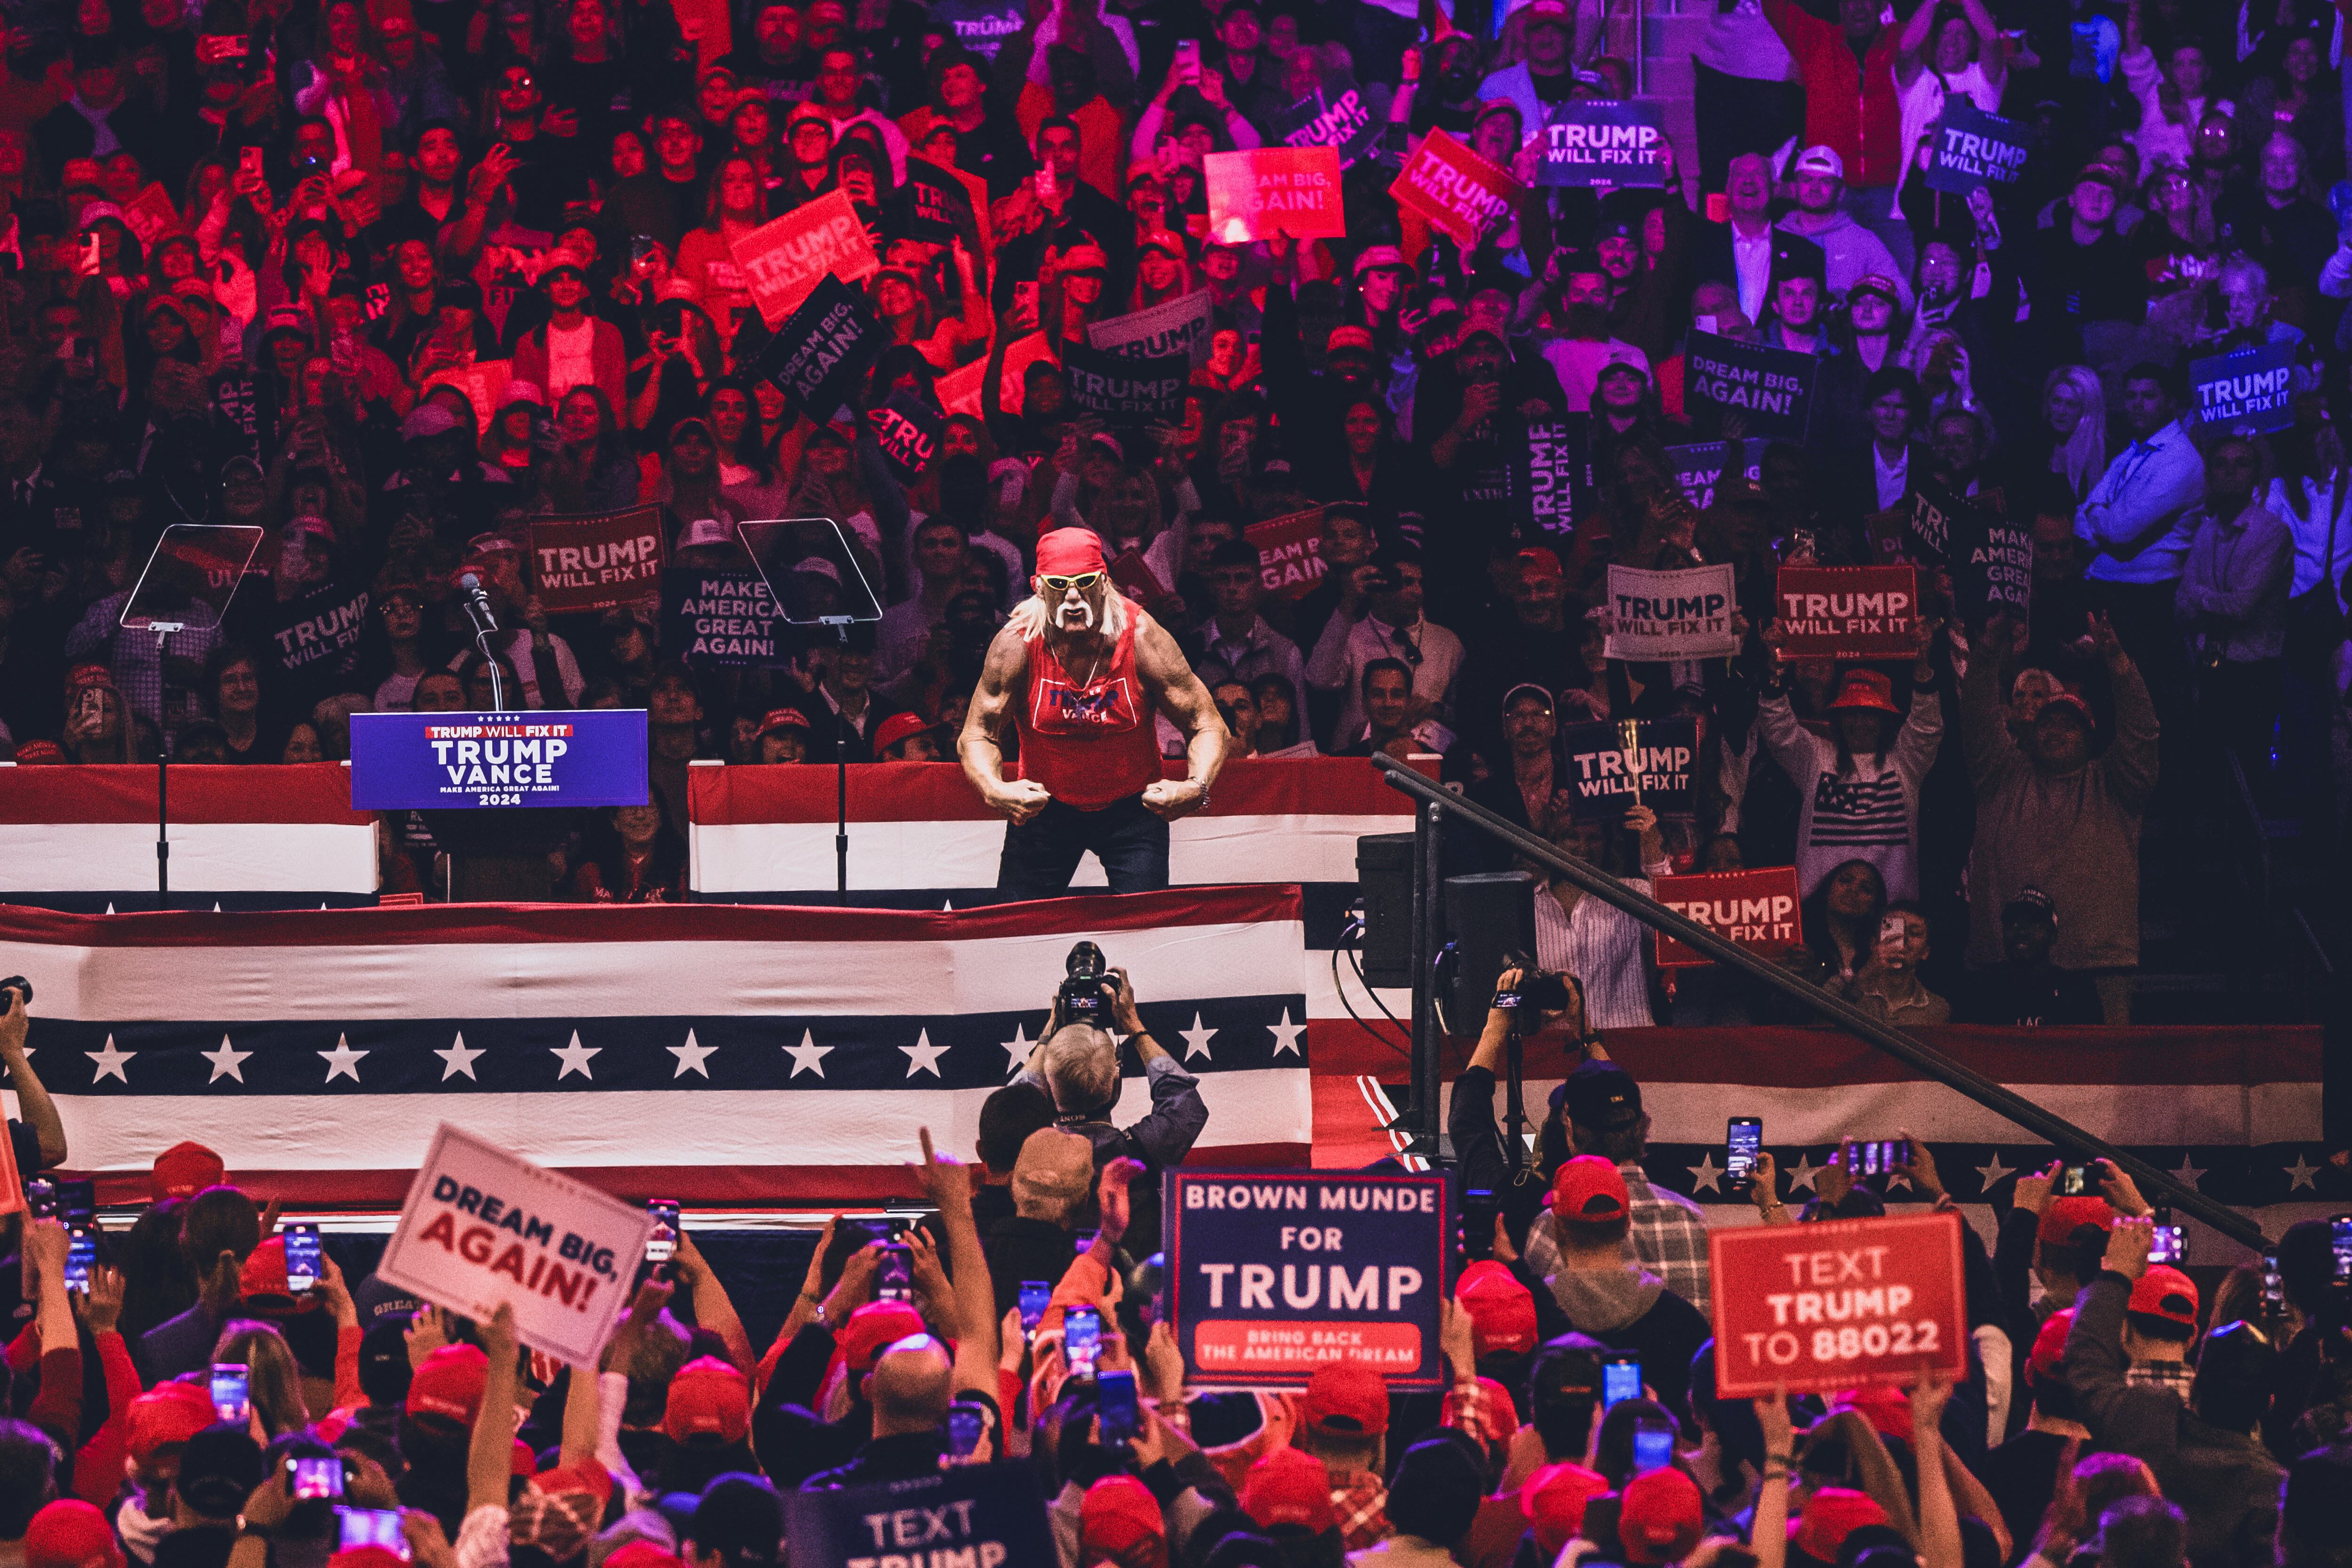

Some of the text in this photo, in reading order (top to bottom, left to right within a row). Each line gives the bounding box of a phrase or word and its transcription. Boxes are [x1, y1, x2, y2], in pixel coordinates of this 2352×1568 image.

[1548, 124, 1659, 149] TRUMP
[1945, 127, 2027, 169] TRUMP
[1548, 148, 1657, 165] WILL FIX IT
[1940, 151, 1983, 176] WILL
[1294, 171, 1332, 188] BIG,
[1410, 168, 1450, 207] WILL
[1421, 150, 1508, 217] TRUMP
[746, 215, 851, 280] TRUMP
[778, 302, 854, 385] DREAM BIG,
[796, 318, 864, 401] AGAIN!
[1068, 366, 1181, 399] TRUMP
[1693, 355, 1803, 396] DREAM BIG,
[2197, 367, 2289, 407] TRUMP
[1071, 390, 1175, 412] WILL FIX IT
[1694, 375, 1793, 416] AGAIN!
[2201, 390, 2289, 423] WILL FIX IT
[242, 403, 258, 435] FIX
[880, 408, 936, 459] TRU
[1552, 422, 1573, 534] WILL FIX IT
[1911, 514, 1944, 554] WILL
[1988, 527, 2033, 550] MAK
[538, 535, 657, 572] TRUMP
[1259, 541, 1303, 566] EAM
[541, 559, 658, 589] WILL FIX IT
[1260, 557, 1329, 590] GAIN
[1986, 565, 2031, 589] GREA
[701, 580, 768, 598] MAKE
[681, 598, 787, 618] AMERICA
[1616, 594, 1724, 620] TRUMP
[1783, 591, 1908, 618] TRUMP
[275, 591, 369, 653] TRUMP
[694, 618, 774, 636] GREAT
[1616, 617, 1724, 635] WILL FIX IT
[1784, 617, 1908, 635] WILL FIX IT
[283, 642, 334, 669] WILL
[691, 637, 775, 656] AGAIN!
[431, 724, 568, 739] TRUMP WILL FIX IT
[431, 739, 567, 764] TRUMP
[1573, 747, 1690, 779] TRUMP
[446, 764, 552, 785] VANCE
[1577, 774, 1690, 797] WILL FIX IT
[479, 793, 521, 805] 2024
[1731, 925, 1767, 941] FIX
[1772, 923, 1794, 939] IT
[1186, 1184, 1436, 1213] BROWN MUNDE
[433, 1174, 618, 1282] DREAM BIG,
[1280, 1226, 1343, 1252] FOR
[420, 1211, 598, 1313] AGAIN!
[1783, 1245, 1890, 1286] TEXT
[1199, 1263, 1423, 1311] TRUMP
[1766, 1285, 1913, 1325] TRUMP
[1247, 1329, 1362, 1345] BRING BACK
[1742, 1320, 1941, 1366] TO 88022
[1203, 1345, 1237, 1360] THE
[1243, 1346, 1343, 1361] AMERICAN
[862, 1499, 977, 1550] TEXT
